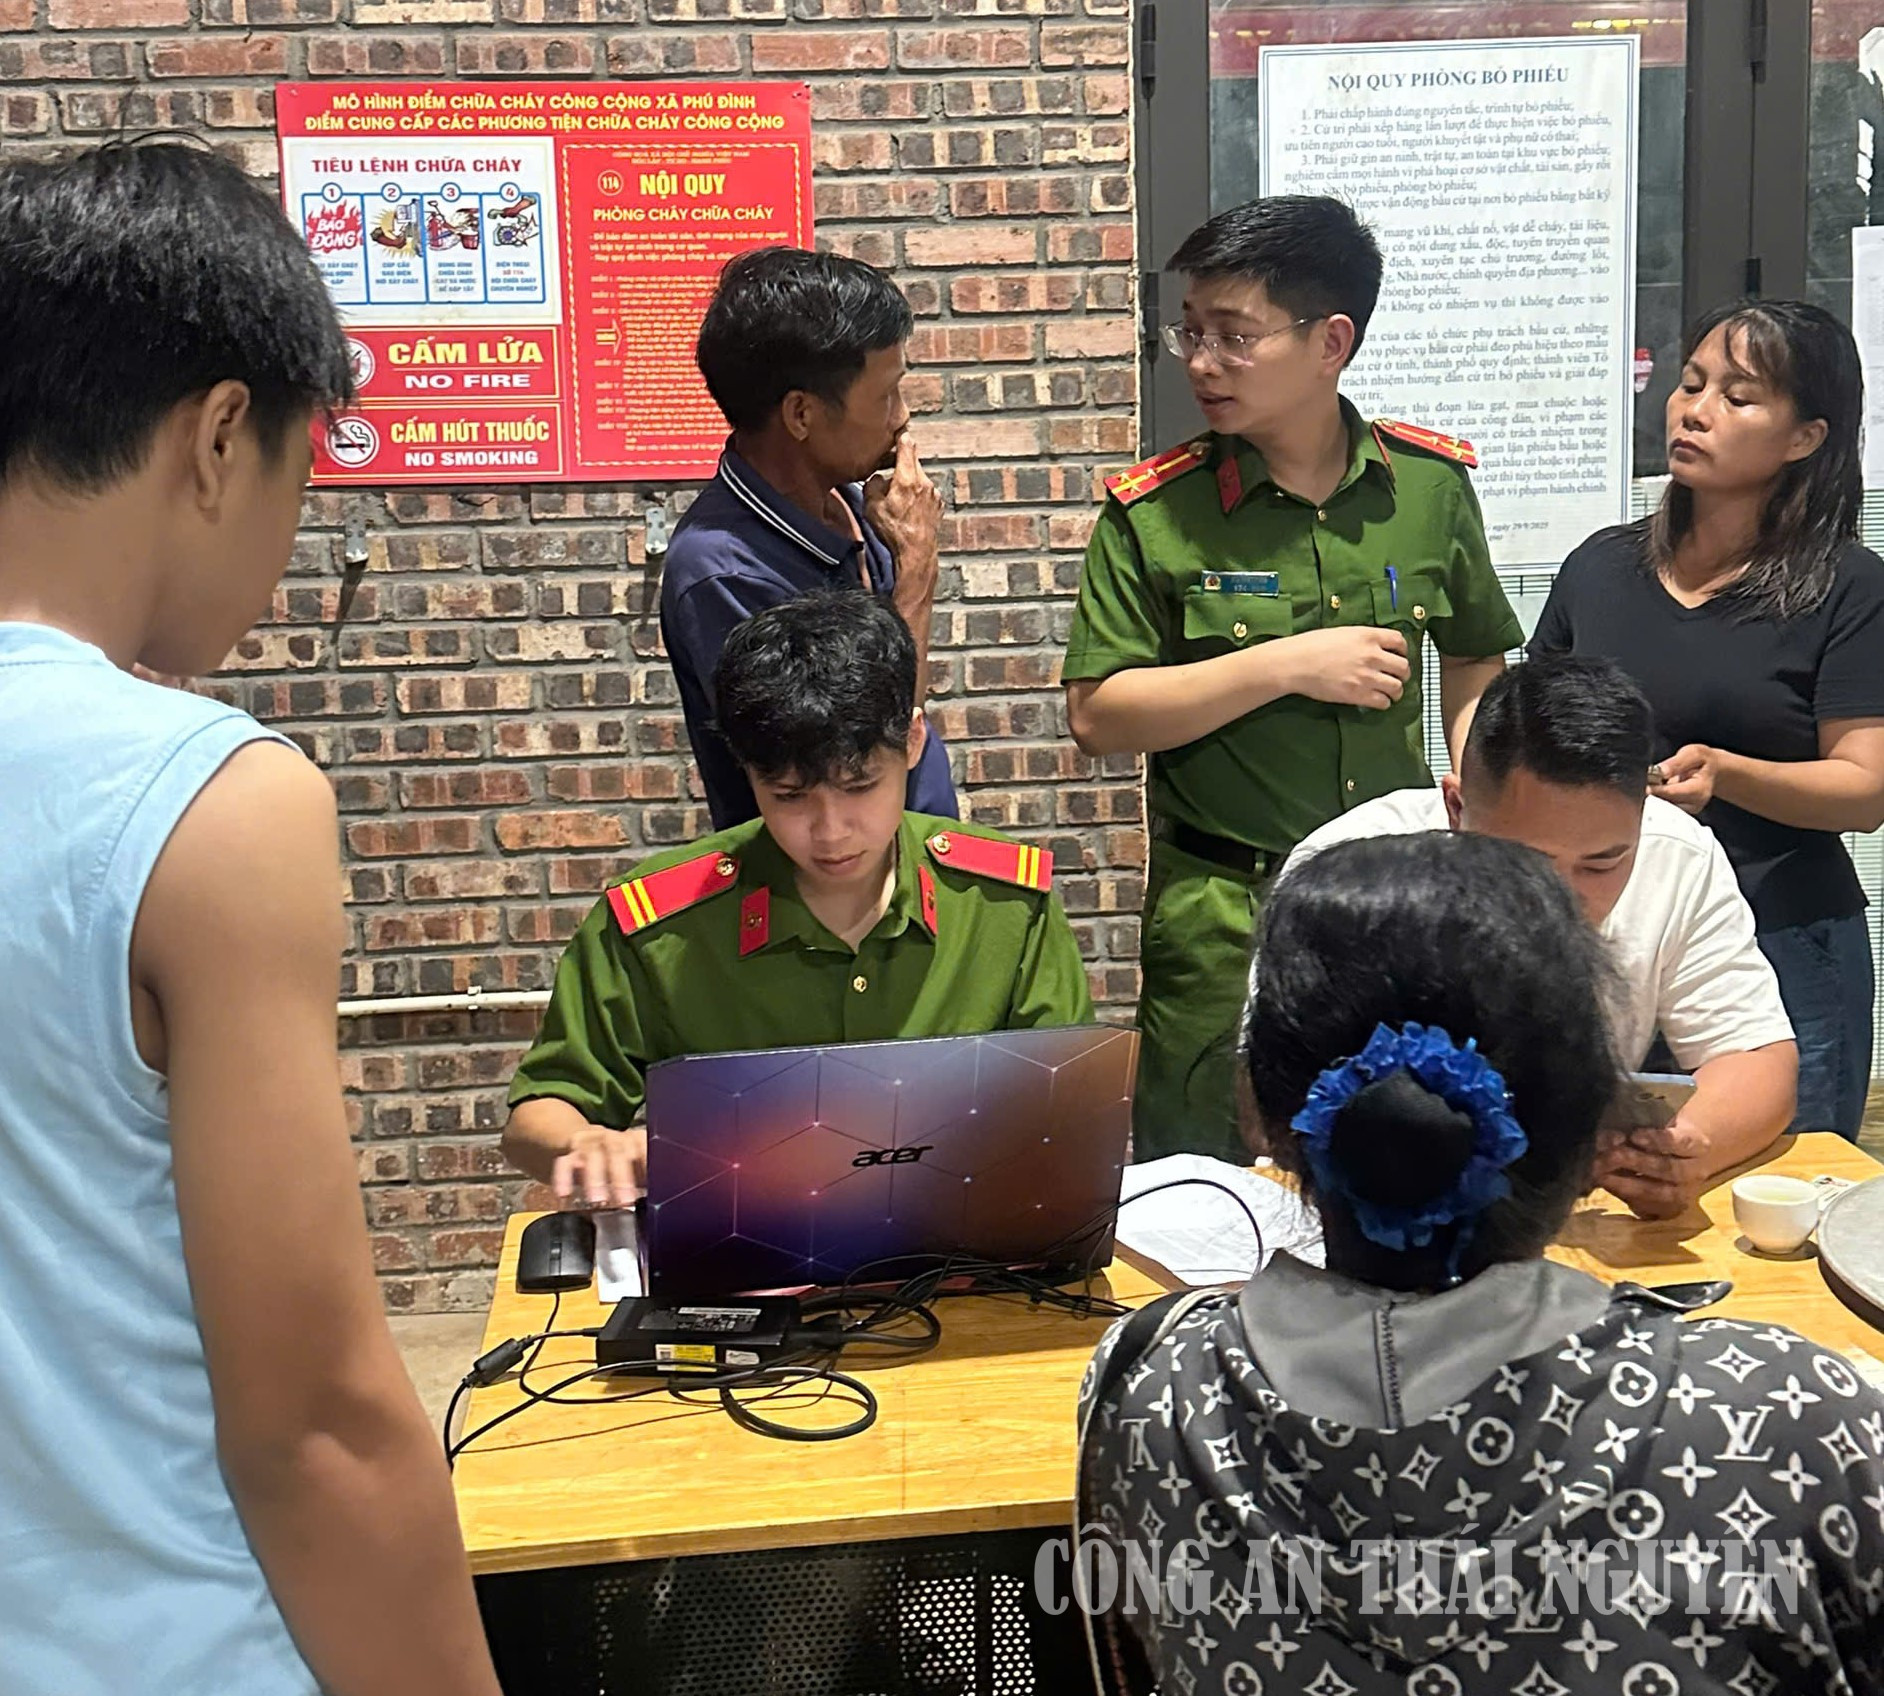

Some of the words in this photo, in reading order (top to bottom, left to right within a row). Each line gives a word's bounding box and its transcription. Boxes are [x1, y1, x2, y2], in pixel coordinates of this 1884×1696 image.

[1328, 73, 1361, 93] NỘI
[1367, 73, 1406, 91] QUY
[1411, 68, 1477, 88] PHÒNG
[1482, 65, 1508, 85] BỎ
[1512, 64, 1570, 83] PHIẾU
[333, 93, 359, 110] MÔ
[364, 93, 403, 110] HÌNH
[407, 89, 446, 110] ĐIỂM
[450, 93, 496, 109] CHỮA
[500, 92, 545, 109] CHÁY
[549, 92, 599, 109] CÔNG
[602, 92, 651, 112] CỘNG
[656, 92, 679, 109] XÃ
[683, 92, 713, 109] PHÚ
[717, 92, 756, 109] ĐÌNH
[1314, 108, 1337, 120] Phải
[1339, 106, 1365, 122] chấp
[1366, 107, 1392, 118] hành
[1394, 106, 1421, 120] đúng
[1423, 104, 1462, 119] nguyên
[1464, 102, 1484, 117] tắc,
[1485, 103, 1510, 114] trình
[1512, 103, 1523, 116] tự
[1525, 102, 1538, 113] bỏ
[1540, 98, 1574, 115] phiếu;
[304, 110, 344, 130] ĐIỂM
[348, 116, 395, 130] CUNG
[400, 111, 434, 130] CẤP
[438, 113, 474, 129] CÁC
[478, 114, 545, 130] PHƯƠNG
[550, 113, 583, 132] TIỆN
[586, 114, 632, 129] CHỮA
[636, 114, 681, 129] CHÁY
[685, 113, 732, 129] CÔNG
[736, 113, 785, 132] CỘNG
[311, 156, 353, 173] TIÊU
[360, 156, 409, 175] LỆNH
[416, 156, 466, 173] CHỮA
[472, 156, 522, 172] CHÁY
[328, 188, 335, 197] 1
[387, 188, 396, 197] 2
[446, 188, 455, 197] 3
[505, 188, 515, 197] 4
[602, 176, 619, 190] 114
[640, 170, 678, 199] NỘI
[684, 173, 726, 198] QUY
[593, 206, 646, 221] PHÒNG
[648, 204, 688, 221] CHÁY
[691, 205, 731, 220] CHỮA
[735, 204, 774, 220] CHÁY
[388, 336, 467, 364] CẤM
[479, 336, 543, 363] LỬA
[405, 375, 453, 389] NO
[464, 374, 531, 388] FIRE
[390, 415, 437, 443] CẤM
[443, 417, 481, 442] HÚT
[485, 414, 550, 442] THUỐC
[405, 452, 435, 466] NO
[440, 451, 538, 466] SMOKING
[851, 1145, 933, 1168] acer
